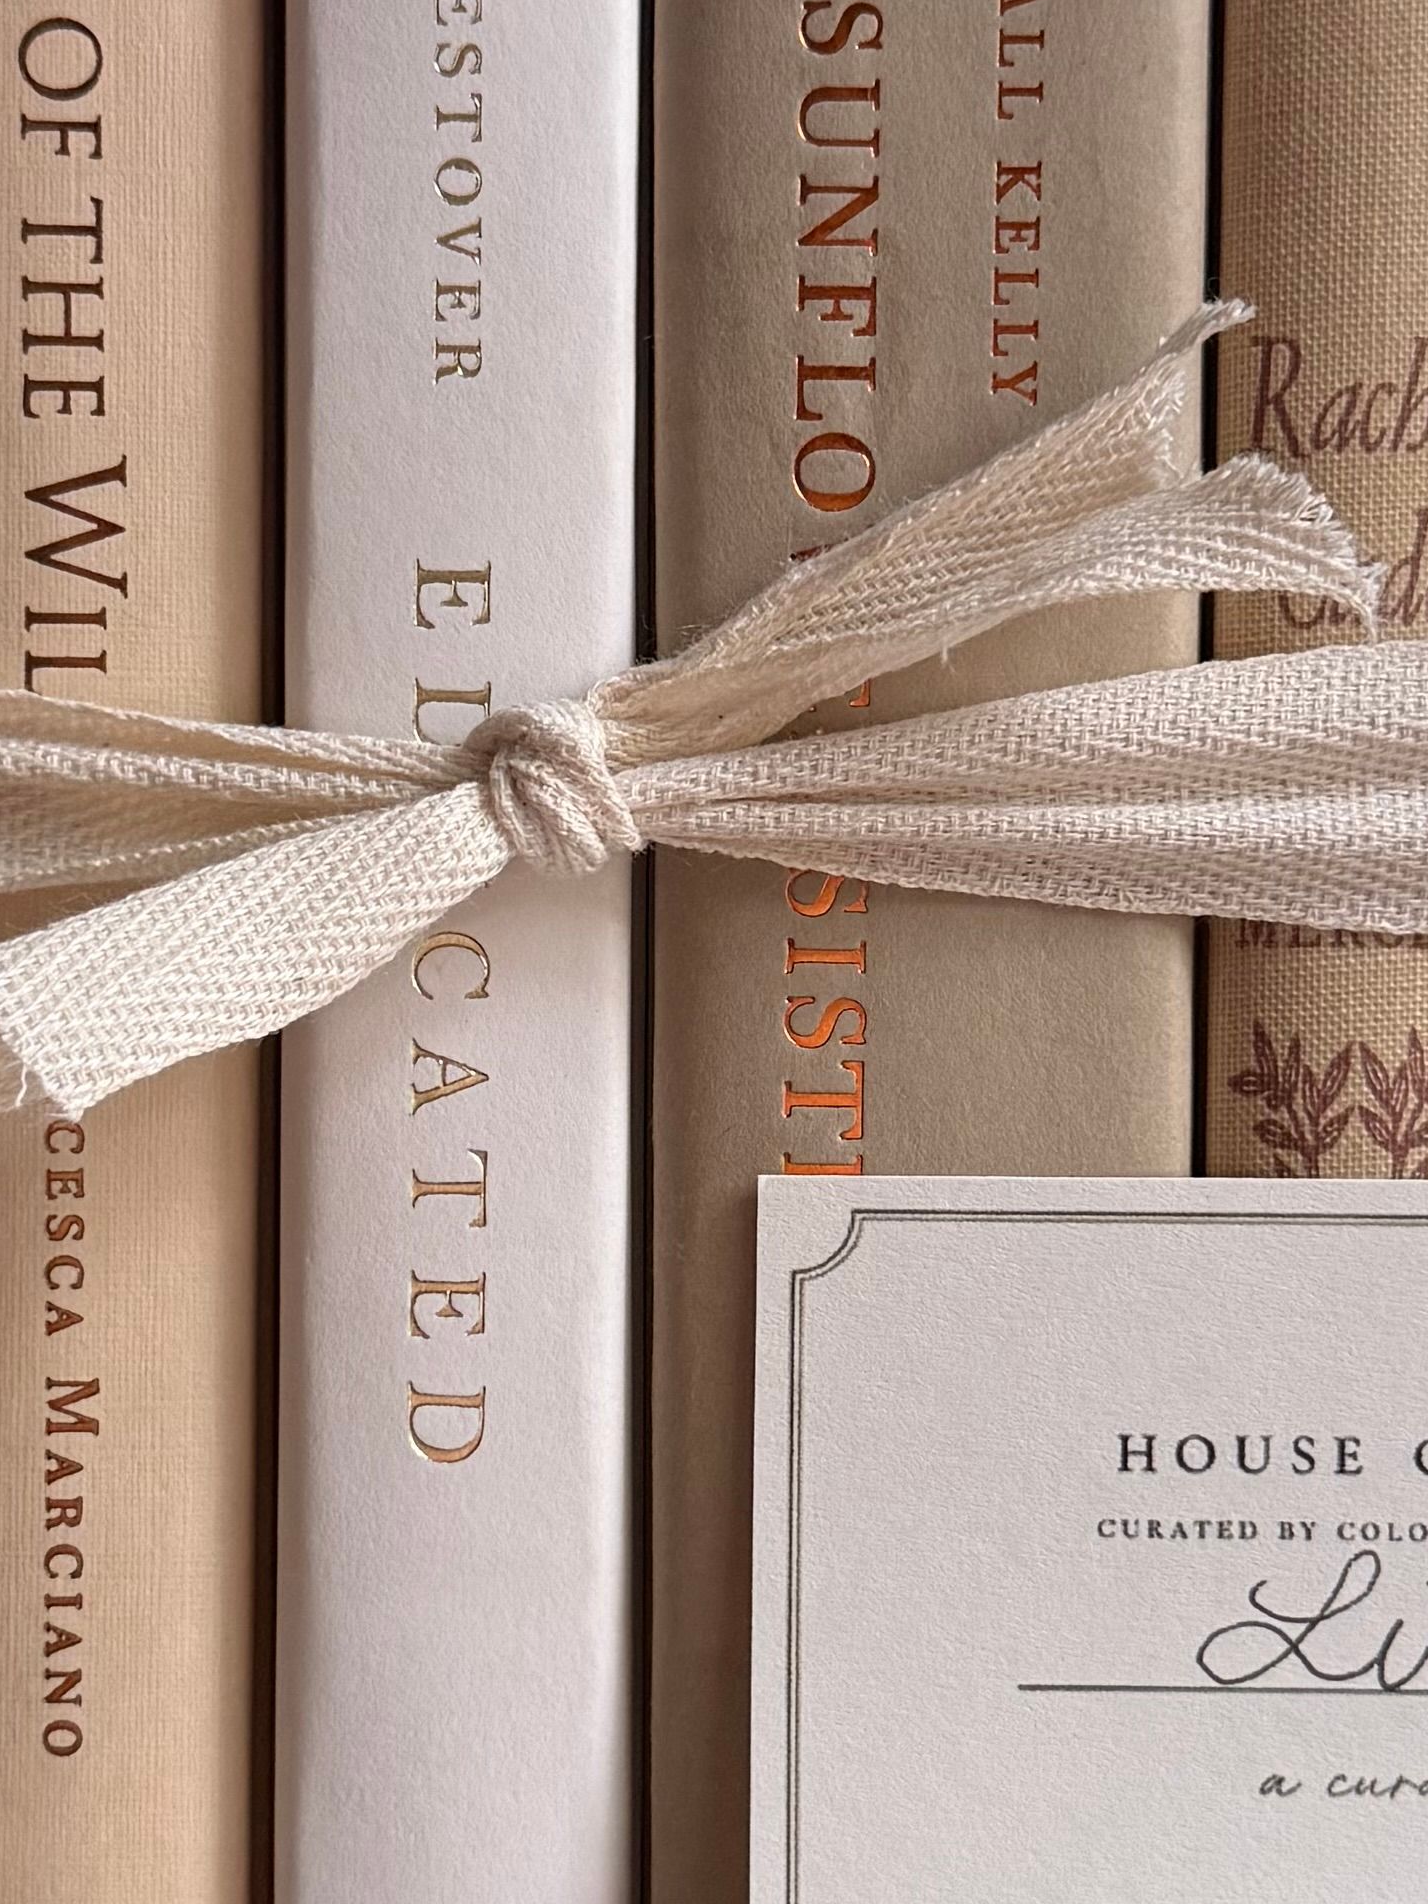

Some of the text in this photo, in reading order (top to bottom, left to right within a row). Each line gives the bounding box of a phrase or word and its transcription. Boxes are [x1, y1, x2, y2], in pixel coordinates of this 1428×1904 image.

[15, 14, 104, 161] OF
[17, 195, 107, 420] THE
[988, 157, 1043, 408] KELLY
[21, 452, 129, 695] WIL
[781, 865, 868, 1175] SIST
[39, 1375, 101, 1759] MARCIANO
[1095, 1517, 1261, 1543] CURATED
[1275, 1519, 1319, 1544] BY
[1115, 1431, 1366, 1479] HOUSE
[1257, 1772, 1305, 1800] a
